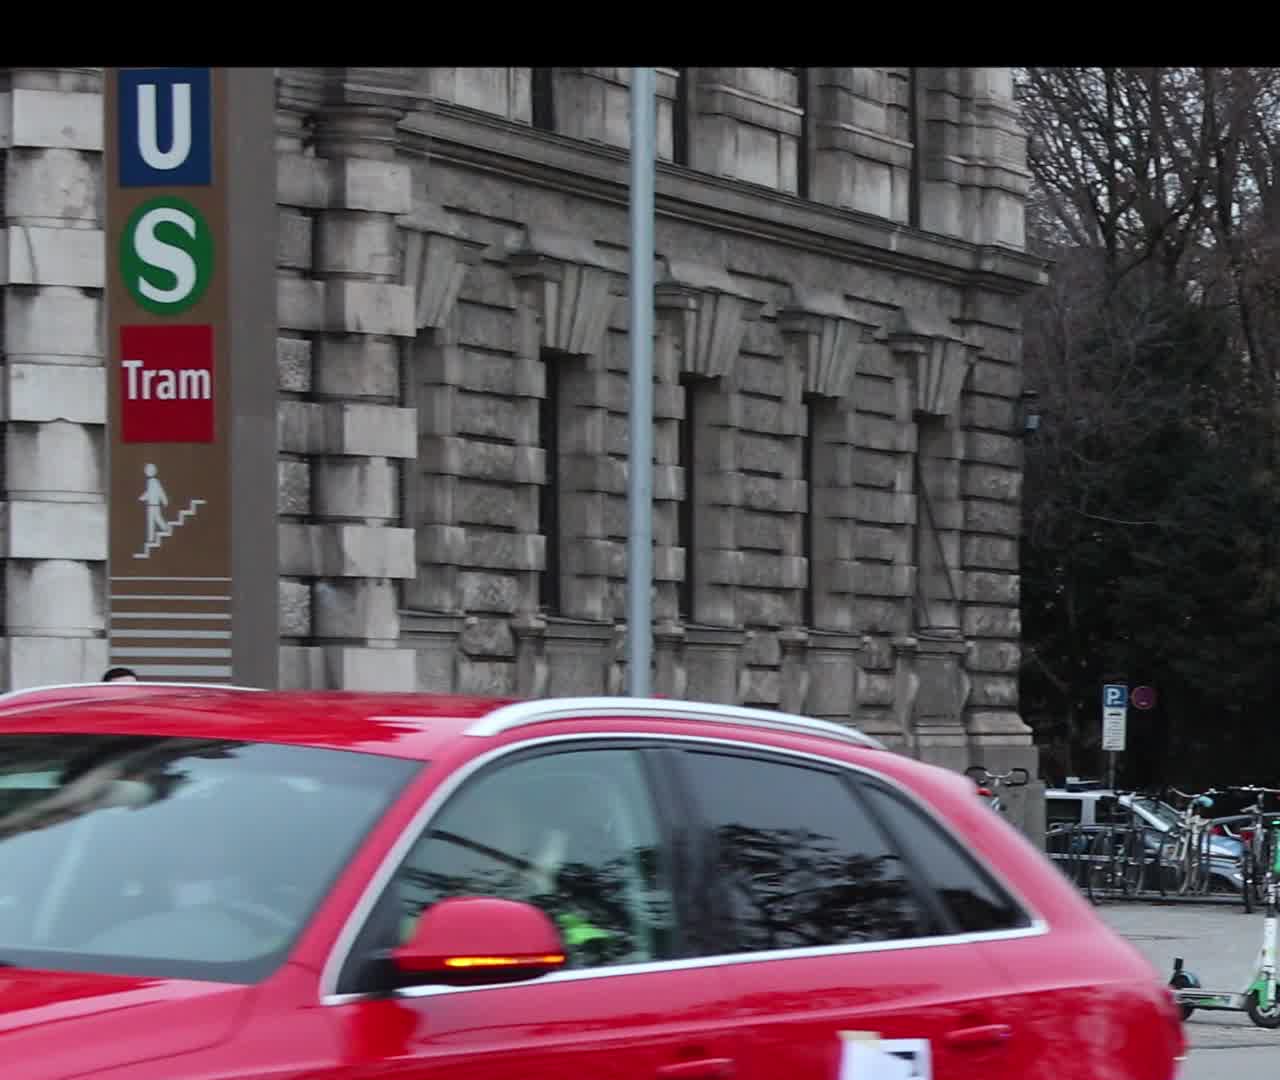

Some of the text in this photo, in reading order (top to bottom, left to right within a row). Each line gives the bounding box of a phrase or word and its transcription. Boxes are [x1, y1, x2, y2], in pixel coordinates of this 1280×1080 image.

[136, 83, 191, 170] U
[133, 207, 197, 303] S
[121, 359, 211, 400] Tram
